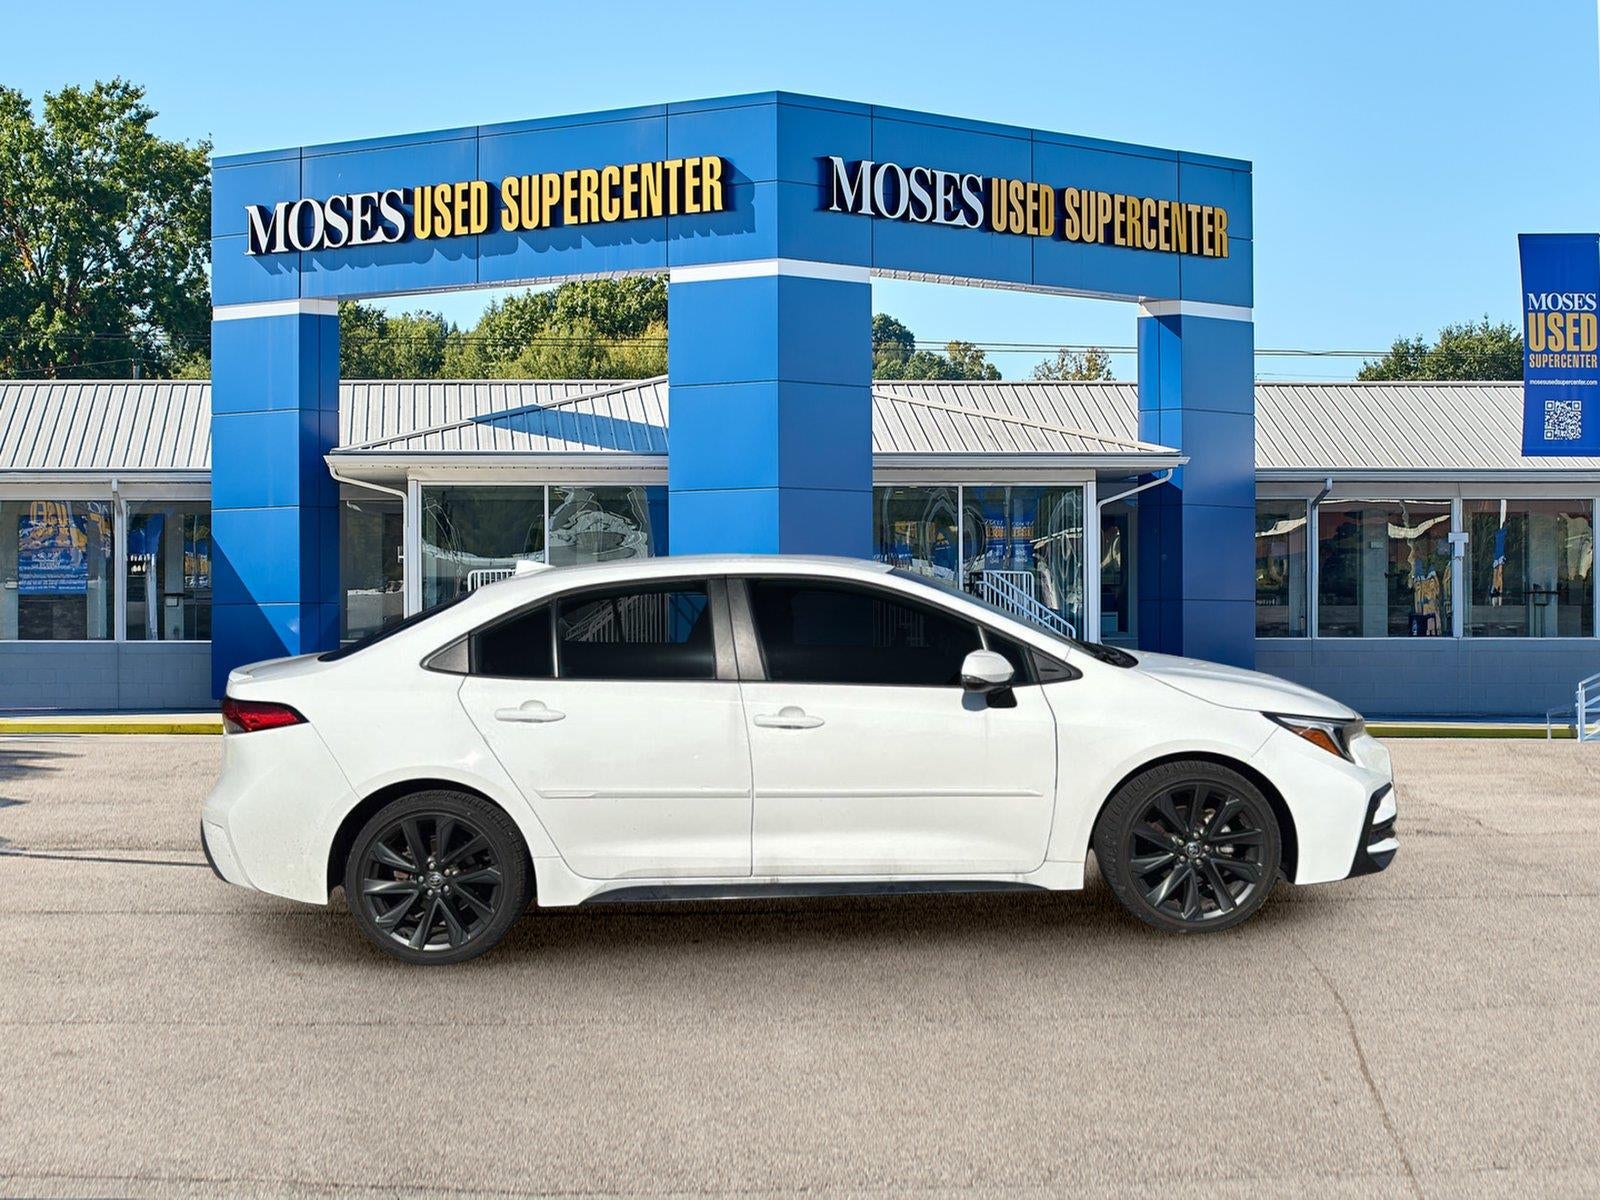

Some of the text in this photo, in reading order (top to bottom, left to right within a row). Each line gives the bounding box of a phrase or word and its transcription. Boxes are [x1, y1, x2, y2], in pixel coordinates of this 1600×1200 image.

[246, 155, 724, 255] MOSES USED SUPERCENTER
[830, 156, 1229, 258] MOSES USED SUPERCENTER
[1528, 293, 1597, 311] MOSES
[1528, 312, 1598, 352] USED
[1529, 353, 1598, 368] SUPERCENTER
